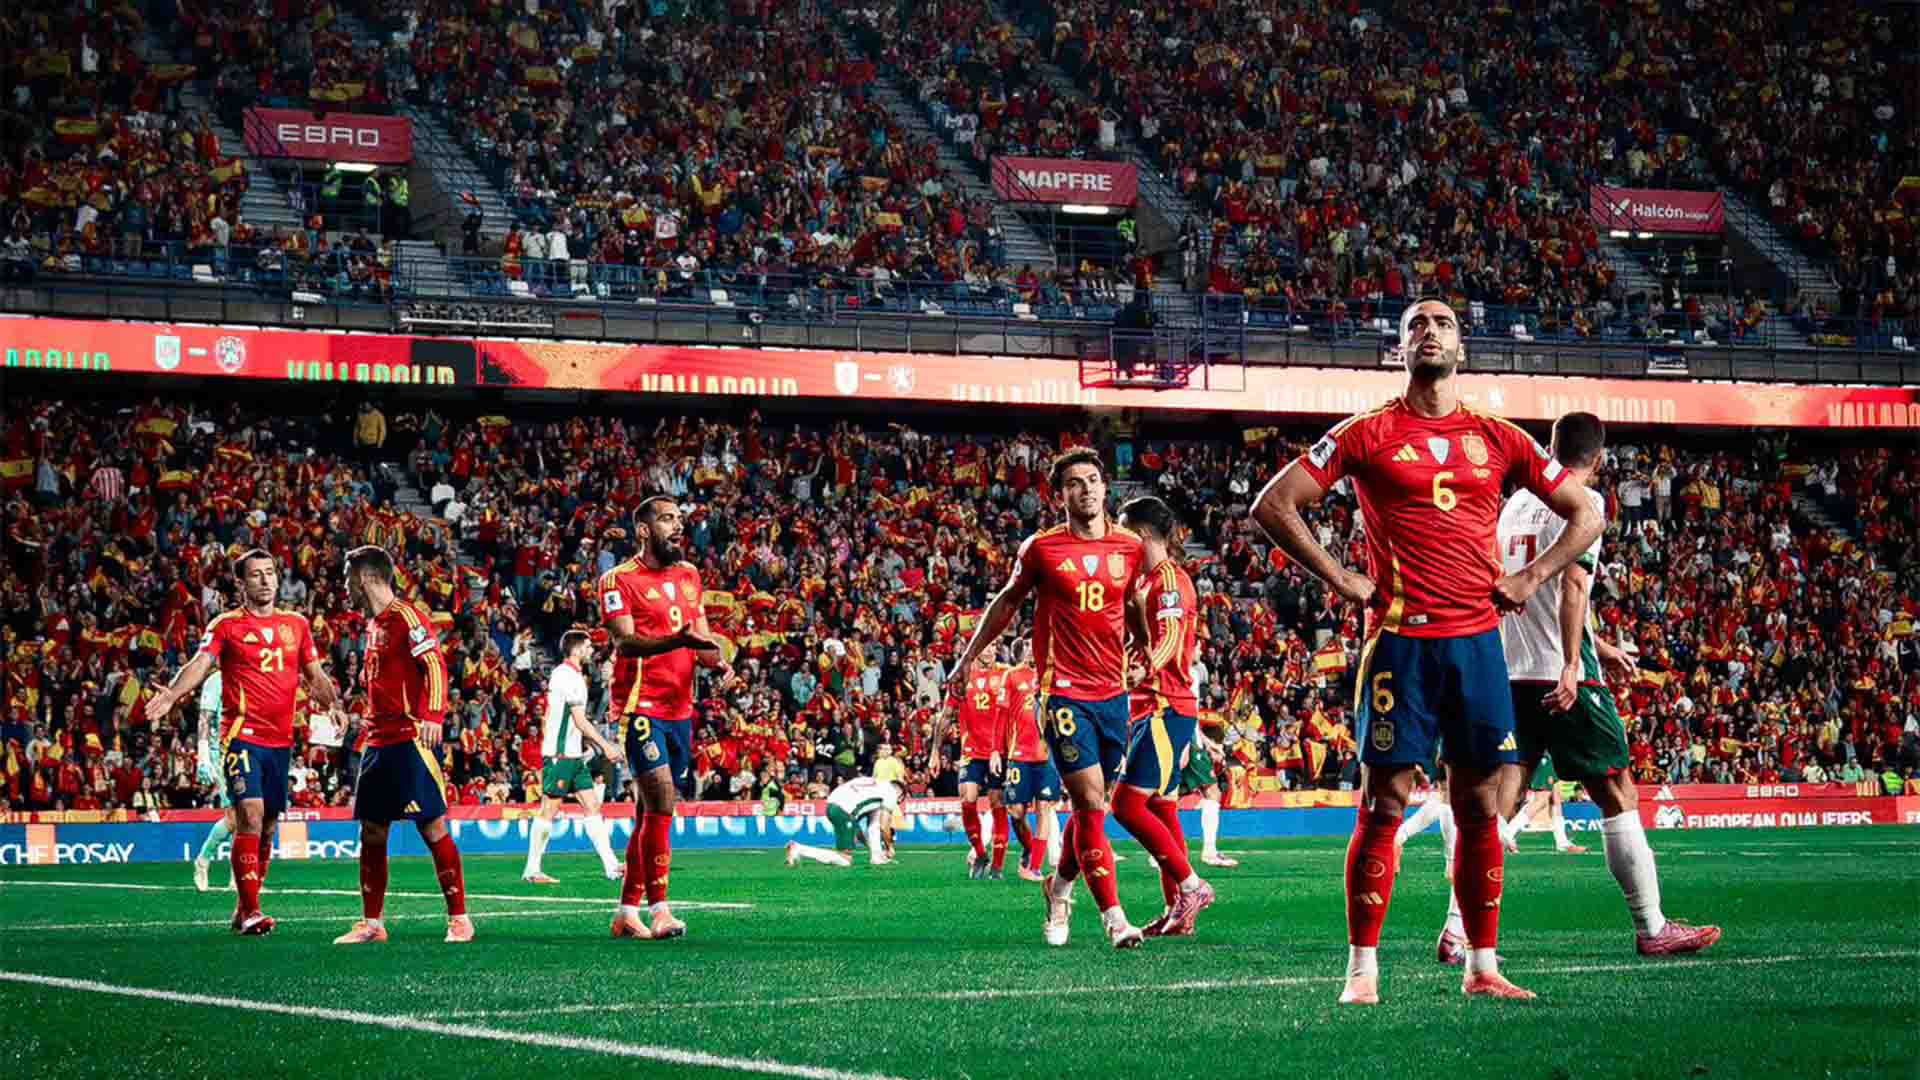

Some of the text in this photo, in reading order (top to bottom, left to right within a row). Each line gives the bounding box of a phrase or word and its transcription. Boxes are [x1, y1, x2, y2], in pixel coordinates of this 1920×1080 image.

[278, 124, 379, 146] EBRO
[1017, 169, 1113, 191] MAPFRE
[1632, 203, 1684, 218] Halcón
[1433, 471, 1457, 512] 6
[1075, 581, 1105, 613] 18
[669, 605, 682, 633] 9
[260, 648, 284, 672] 21
[974, 693, 990, 710] 12
[1373, 671, 1394, 713] 6
[634, 715, 651, 741] 9
[226, 750, 251, 777] 21
[1688, 811, 1873, 827] EUROPEAN QUALIFIERS
[55, 843, 135, 863] POSAY
